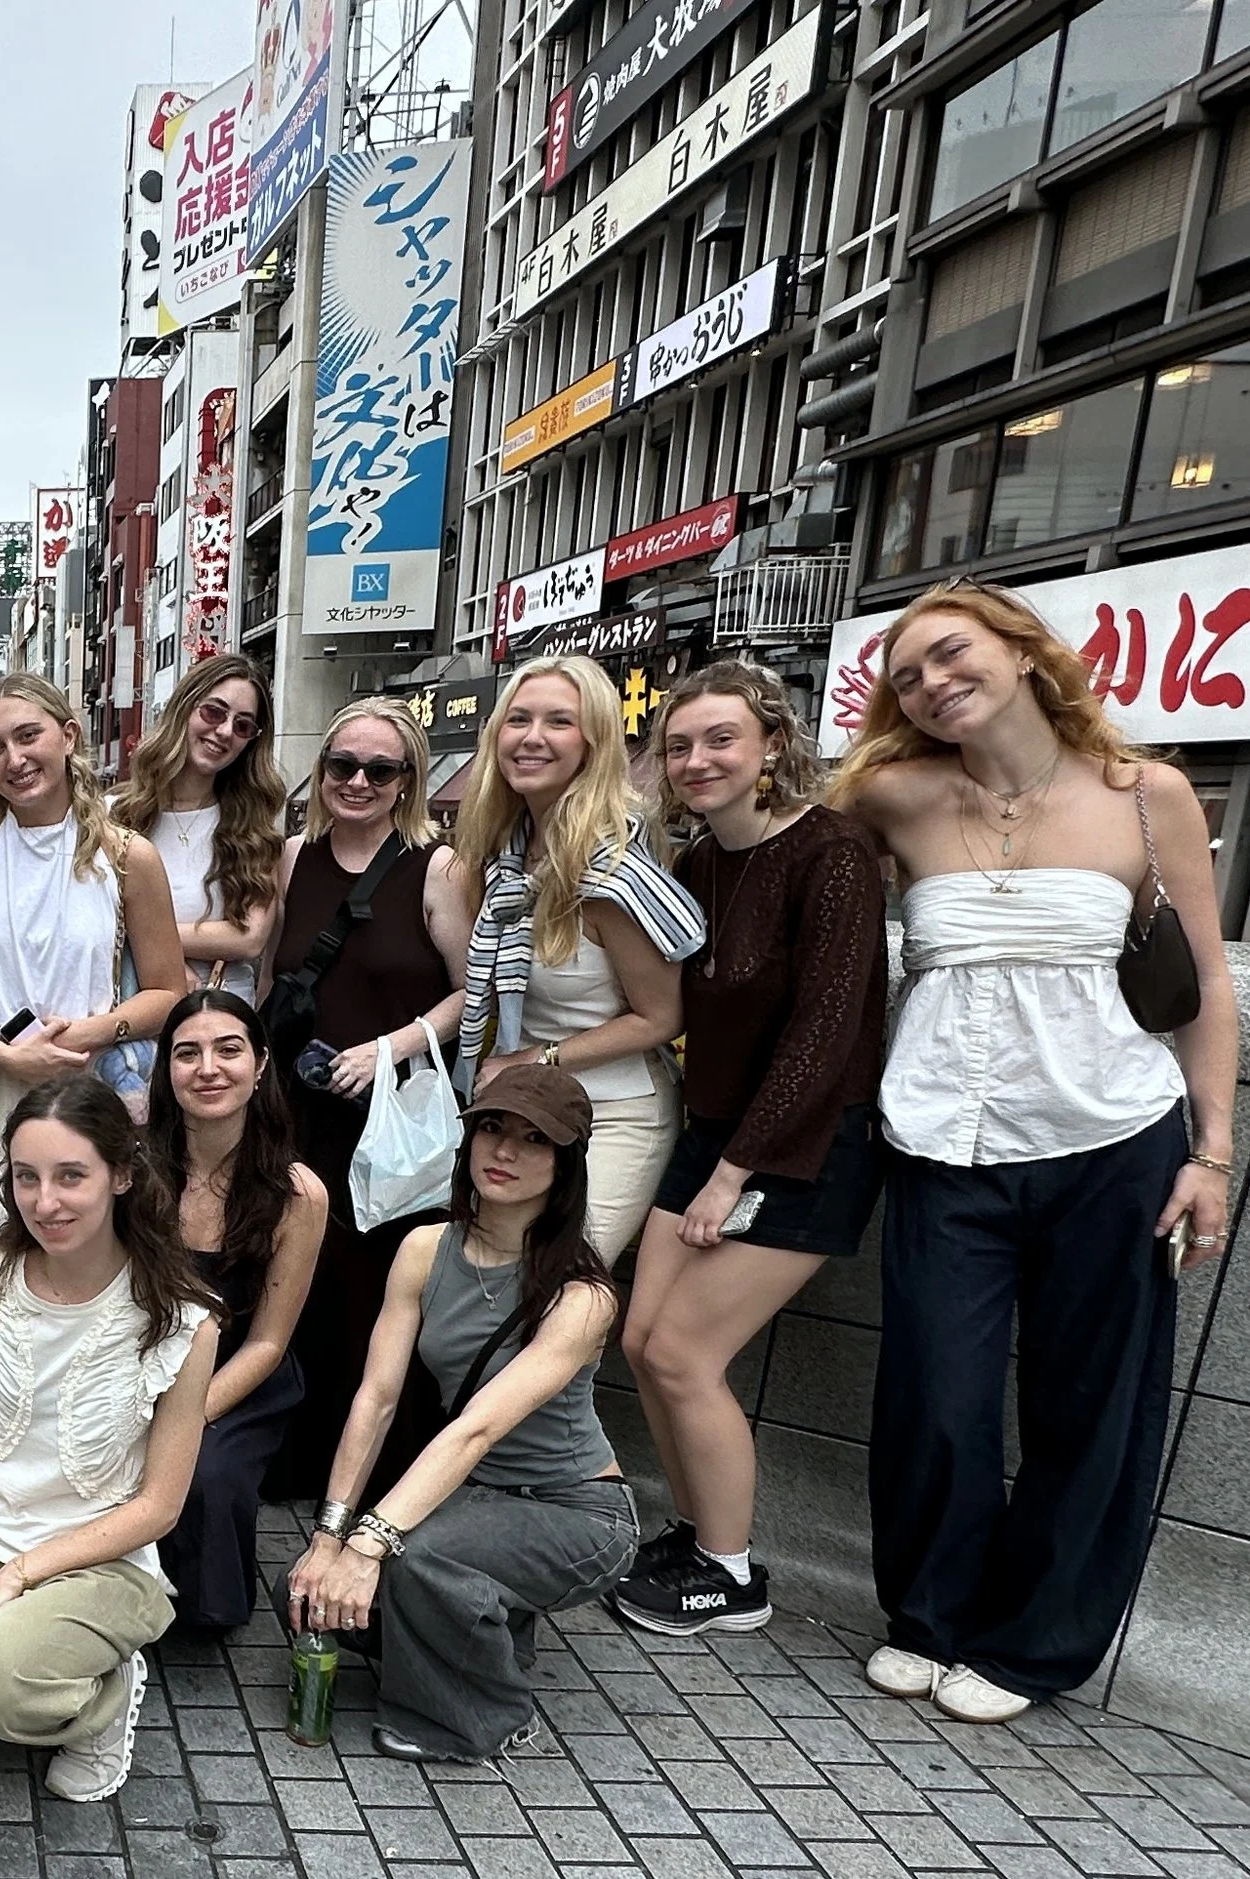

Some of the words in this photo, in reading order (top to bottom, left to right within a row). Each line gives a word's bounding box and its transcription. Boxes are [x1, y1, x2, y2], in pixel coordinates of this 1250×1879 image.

[176, 106, 236, 188] 入店
[549, 102, 567, 180] 5F
[668, 63, 772, 196] 白木屋
[537, 202, 610, 298] 白木屋
[618, 353, 632, 407] 3F
[356, 572, 385, 593] BX
[496, 594, 507, 651] 2F
[446, 696, 478, 718] COFFEE
[681, 1592, 727, 1611] HOKA
